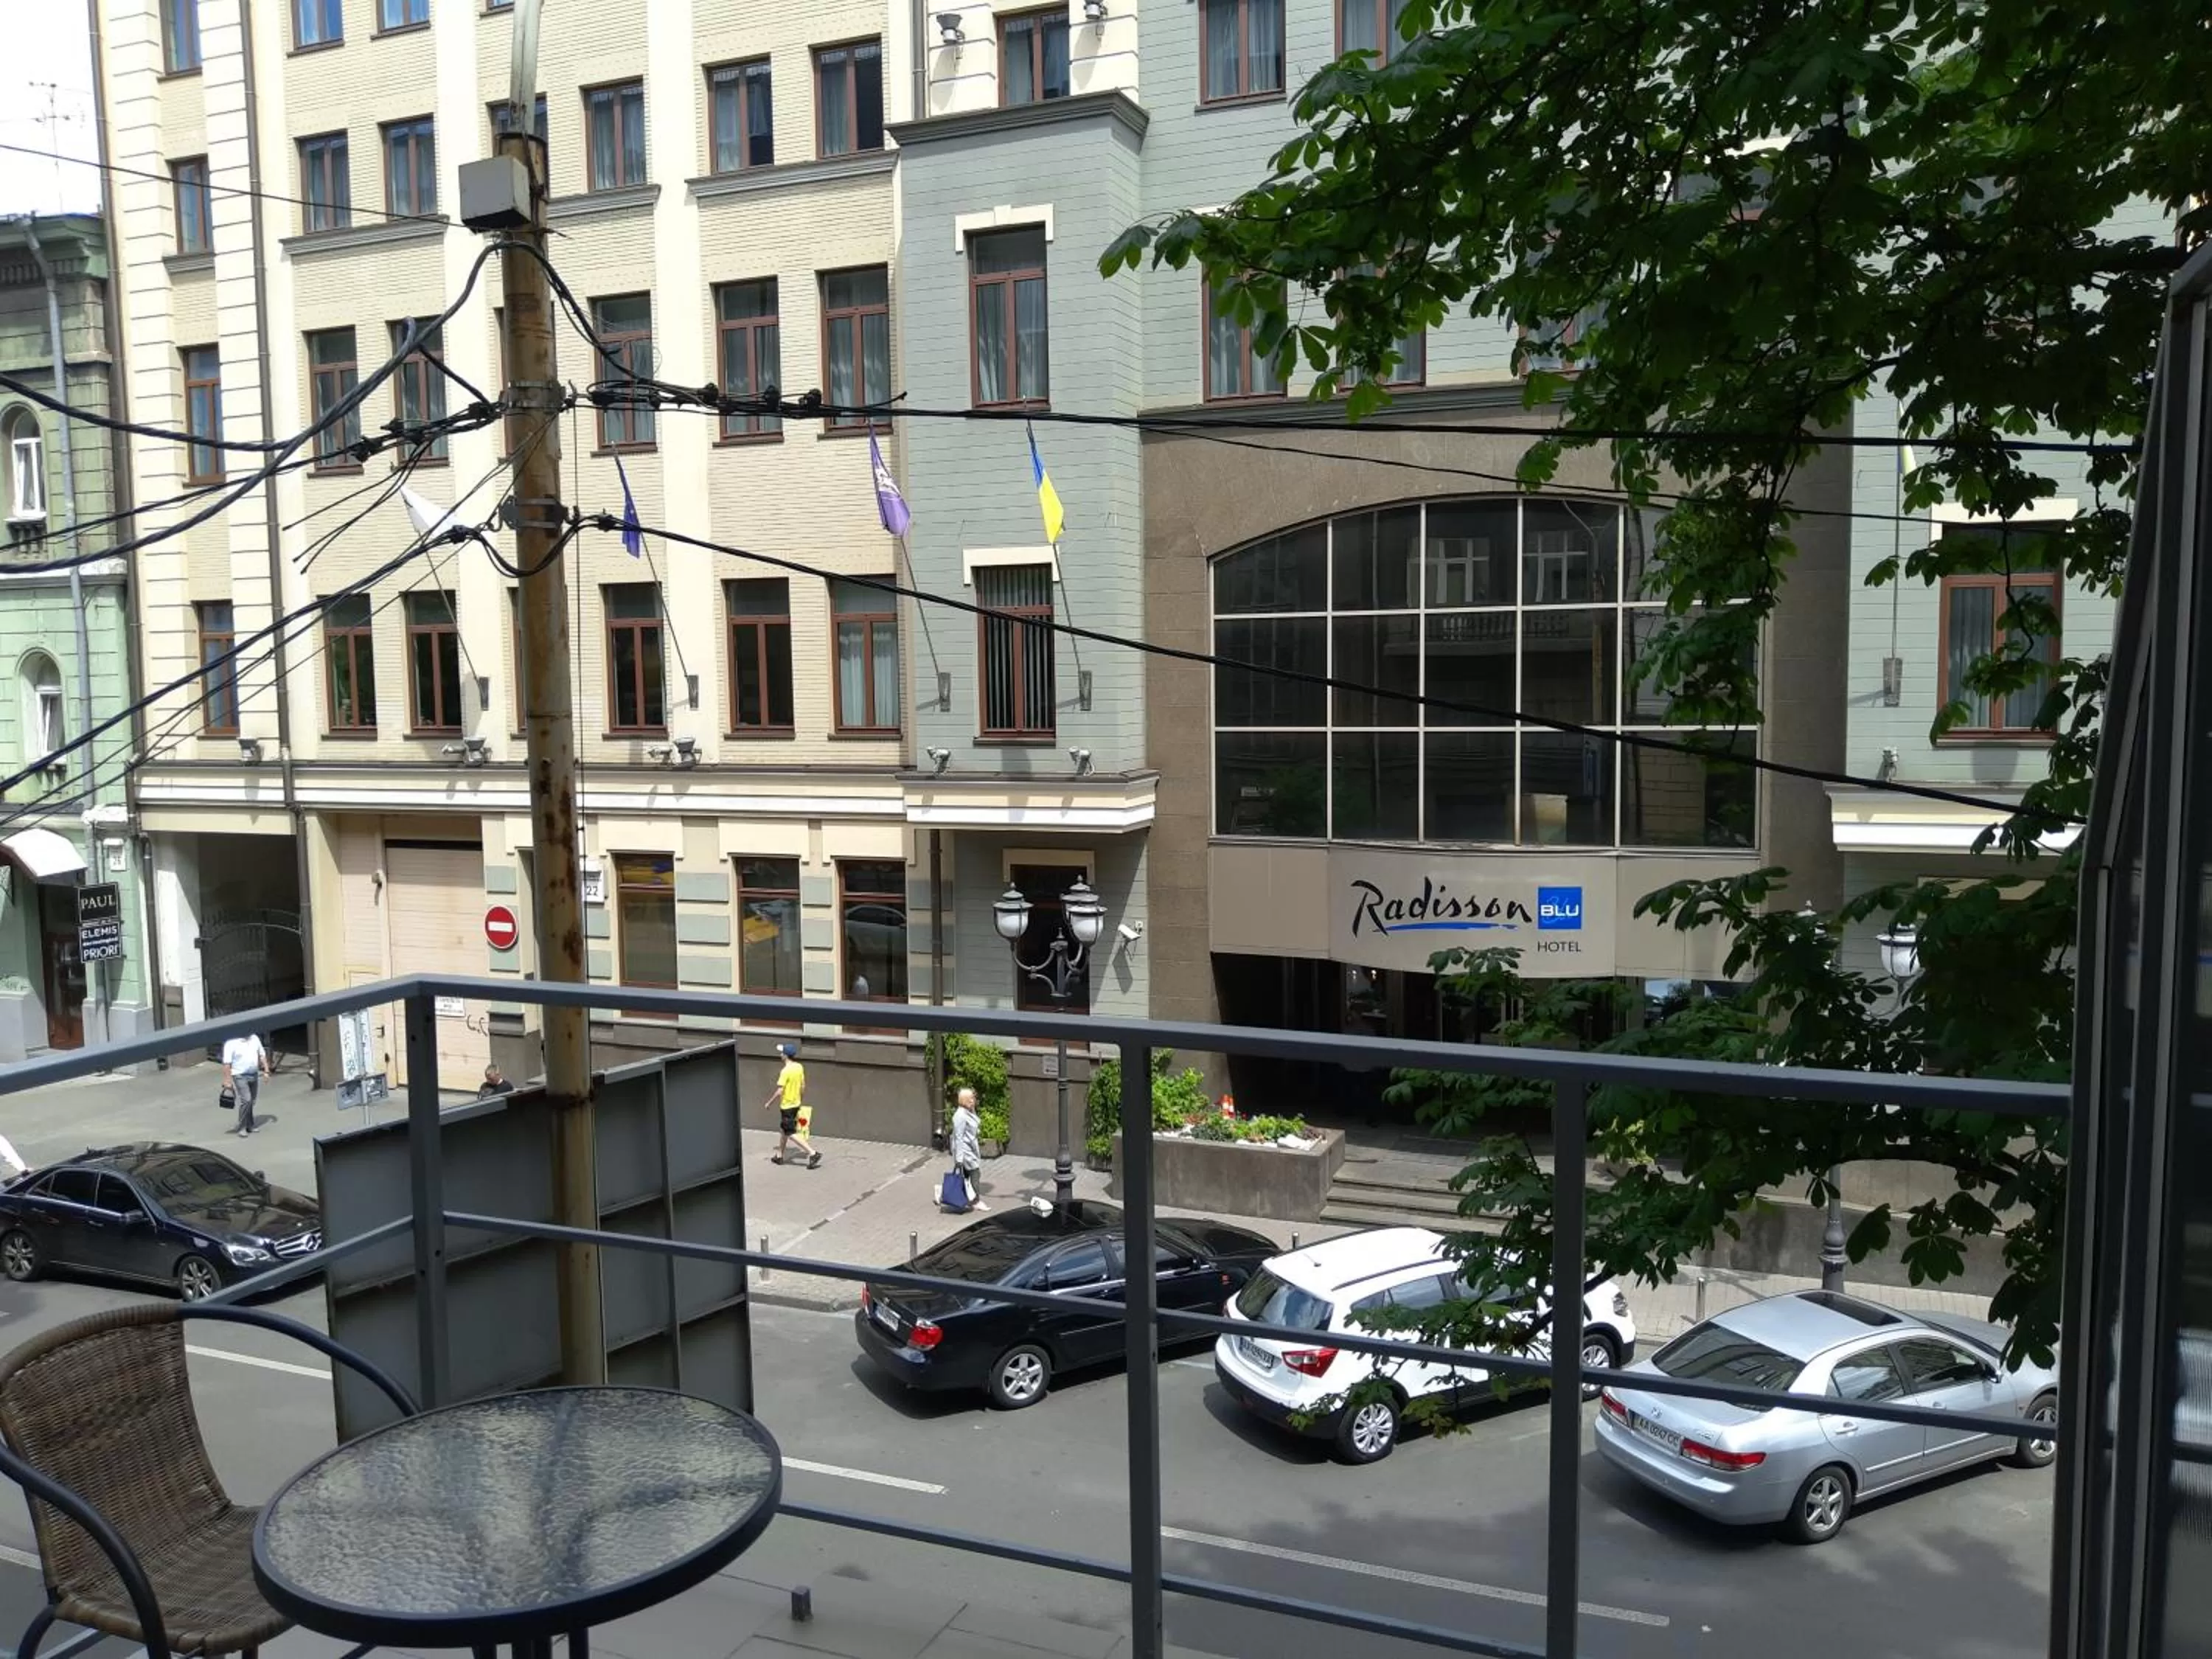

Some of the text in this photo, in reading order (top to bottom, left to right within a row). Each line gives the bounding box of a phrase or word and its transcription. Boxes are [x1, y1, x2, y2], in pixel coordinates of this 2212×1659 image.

[81, 894, 115, 909] PAUL
[1350, 876, 1579, 937] Radisson BLU
[82, 925, 117, 939] ELEMIS
[83, 944, 118, 960] PRIORI
[1537, 941, 1582, 953] HOTEL
